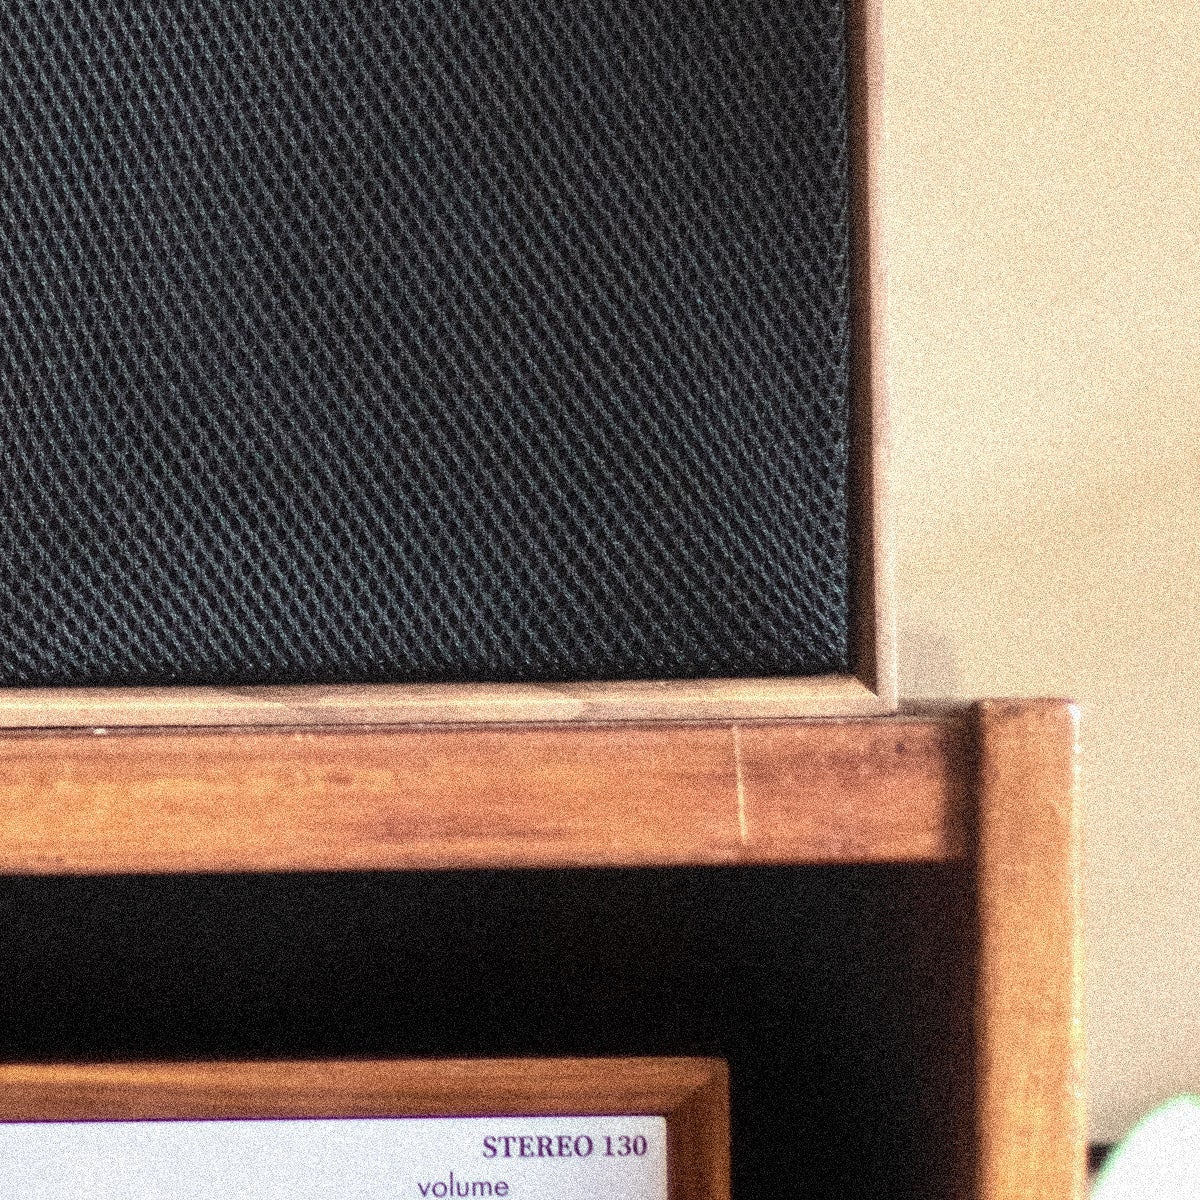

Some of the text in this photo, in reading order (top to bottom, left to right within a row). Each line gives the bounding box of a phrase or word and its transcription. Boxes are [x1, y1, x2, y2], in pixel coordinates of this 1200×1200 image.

[482, 1134, 648, 1159] STEREO 130
[417, 1172, 510, 1198] volume
